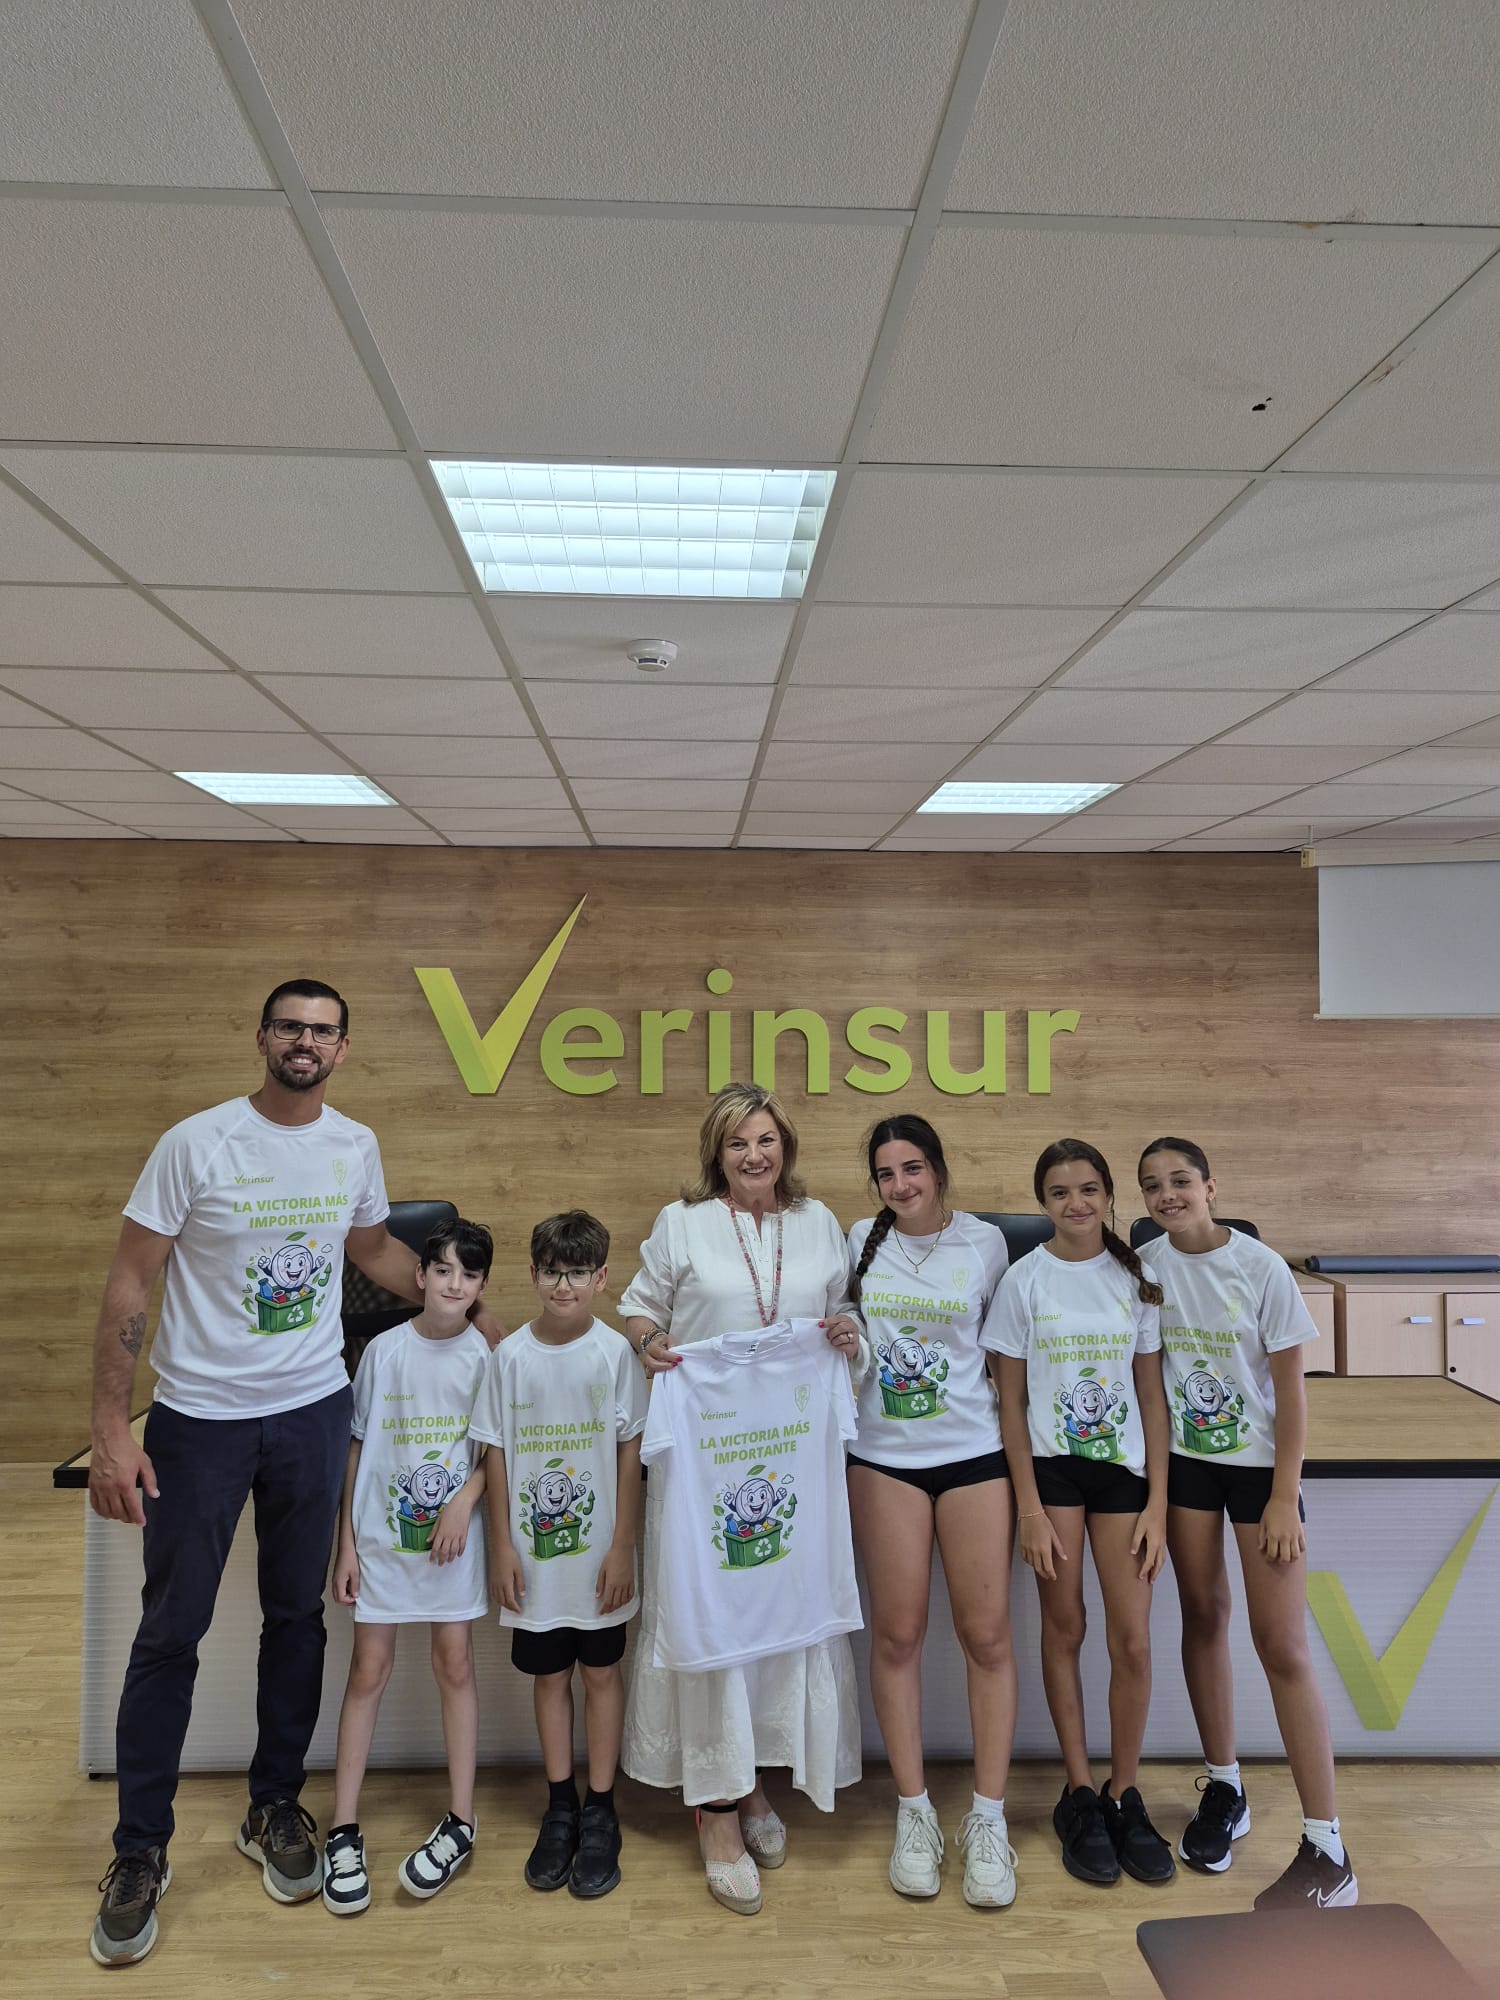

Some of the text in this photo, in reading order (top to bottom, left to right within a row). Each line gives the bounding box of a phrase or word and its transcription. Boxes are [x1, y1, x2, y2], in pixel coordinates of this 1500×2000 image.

[413, 893, 1081, 1095] Verinsur
[234, 1174, 274, 1184] Verinsur
[233, 1192, 348, 1213] LA VICTORIA MÁS
[249, 1211, 339, 1229] IMPORTANTE
[873, 1291, 935, 1309] VICTORIA
[939, 1298, 969, 1313] MÁS
[867, 1306, 952, 1325] IMPORTANTE
[1036, 1338, 1049, 1349] LA
[1050, 1334, 1108, 1347] VICTORIA
[1215, 1330, 1242, 1345] MÁS
[381, 1418, 396, 1430] LA
[398, 1415, 456, 1430] VICTORIA
[700, 1409, 737, 1421] Verinsur
[519, 1423, 577, 1438] VICTORIA
[580, 1417, 606, 1434] MÁS
[699, 1420, 810, 1450] LA VICTORIA MÁS
[515, 1437, 593, 1455] IMPORTANTE
[713, 1440, 798, 1465] IMPORTANTE
